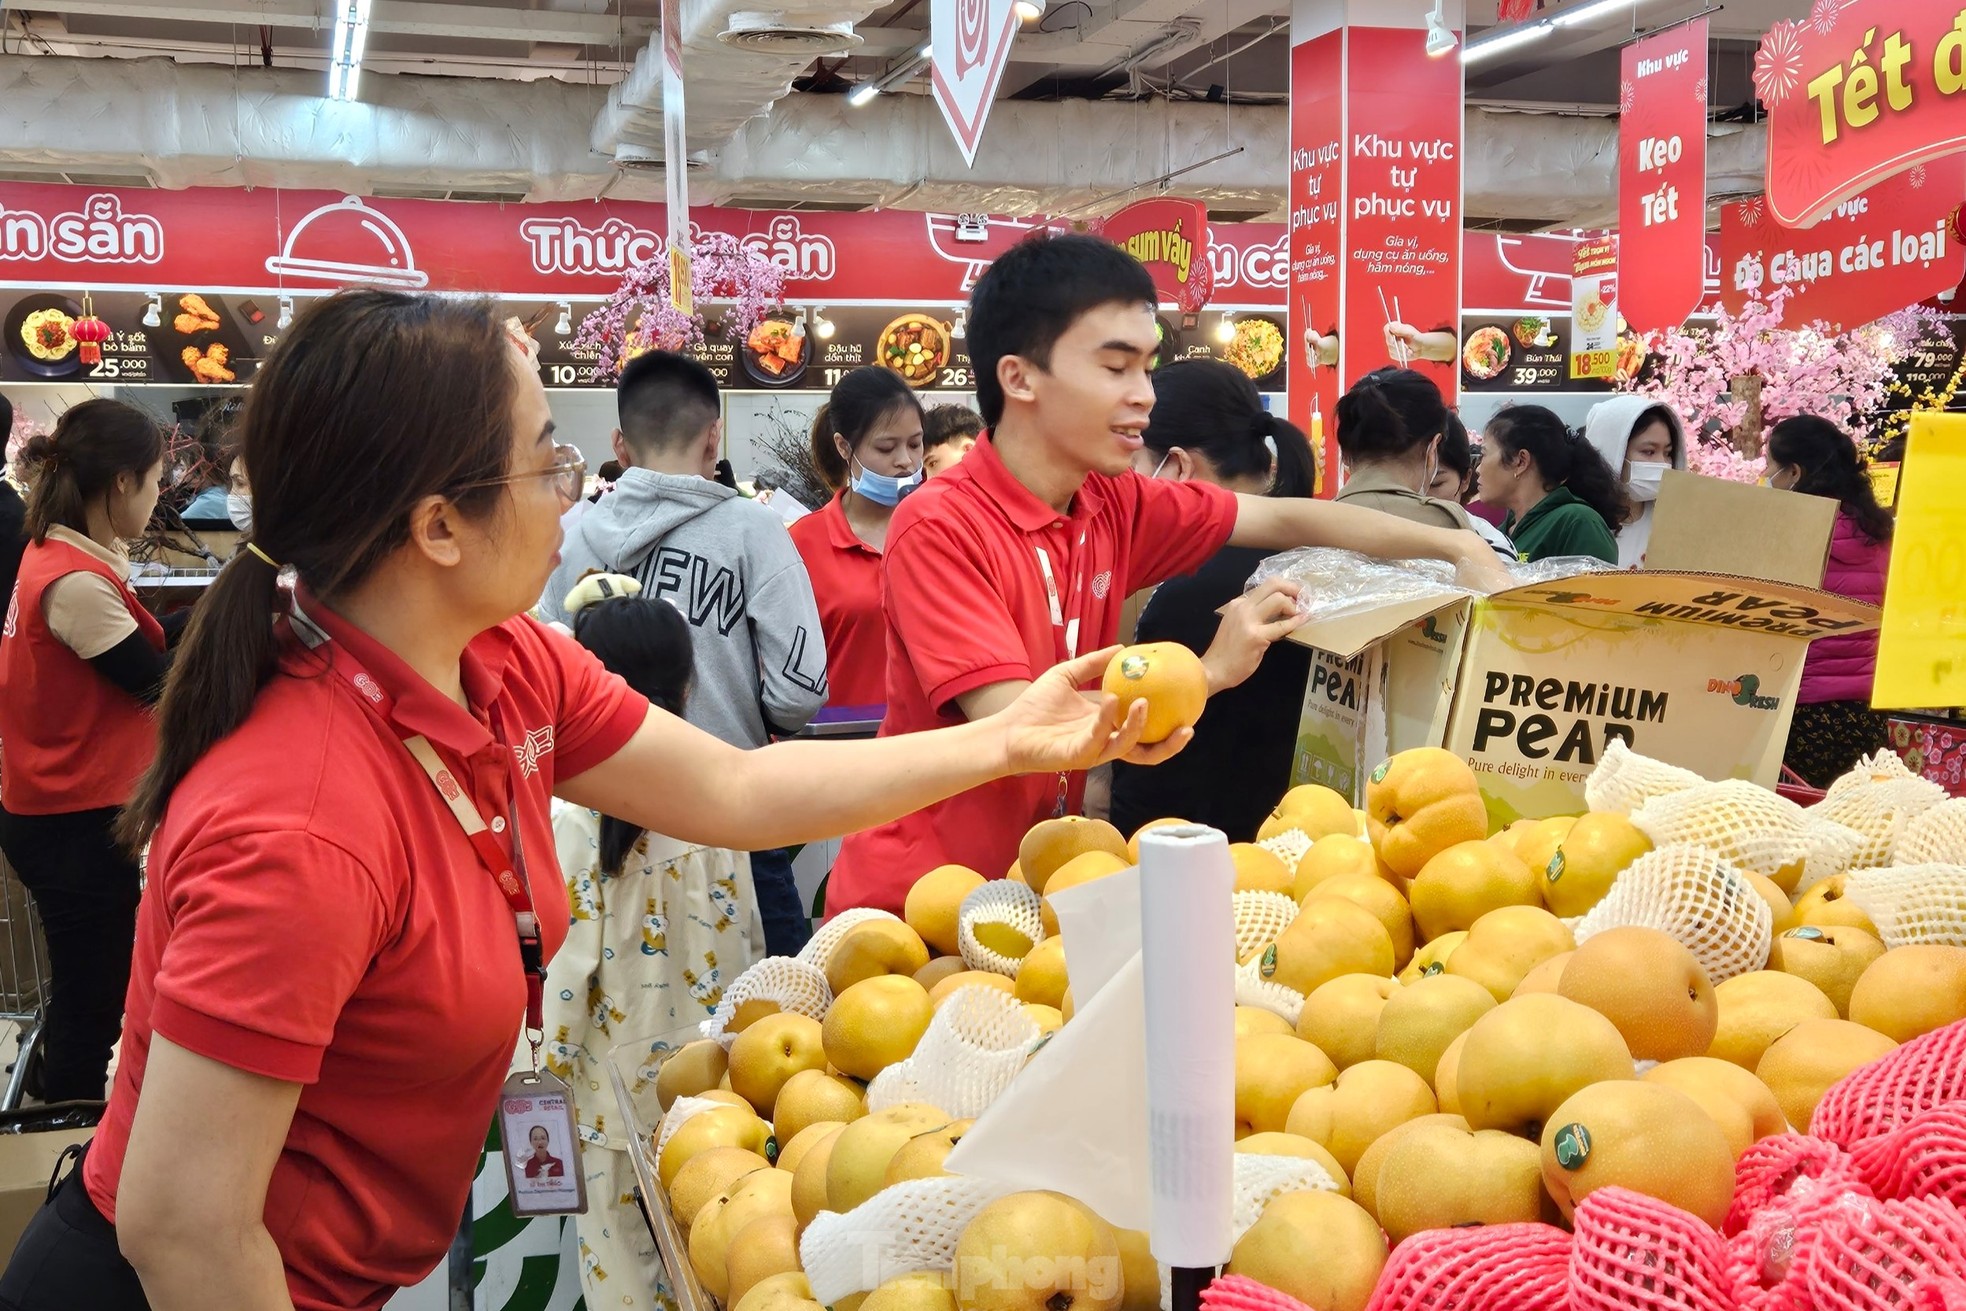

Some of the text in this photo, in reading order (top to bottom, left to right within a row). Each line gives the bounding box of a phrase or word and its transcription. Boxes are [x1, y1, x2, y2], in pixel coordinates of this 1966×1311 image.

[1637, 48, 1689, 79] Khu vực
[1807, 27, 1913, 145] Tết
[1293, 141, 1339, 172] Khu vực
[1354, 133, 1454, 165] Khu vực
[1638, 135, 1682, 175] Kẹo
[1309, 173, 1322, 200] tự
[1390, 165, 1418, 193] tự
[1293, 201, 1337, 233] phục vụ
[1354, 192, 1451, 223] phục vụ
[1641, 181, 1679, 227] Tết
[1836, 196, 1868, 222] vực
[56, 200, 156, 257] sẵn
[1385, 235, 1404, 247] Gia
[525, 221, 657, 272] Thức
[1353, 248, 1383, 262] dụng
[1385, 250, 1399, 261] cụ
[1402, 249, 1416, 260] ăn
[1839, 234, 1885, 274] các
[1892, 218, 1946, 269] loại
[102, 342, 118, 352] bò
[694, 342, 734, 353] Gà quay
[715, 353, 734, 361] con
[828, 344, 848, 353] Đậu
[846, 353, 862, 363] thịt
[1187, 345, 1211, 354] Canh
[1525, 354, 1562, 362] Bún Thái
[1914, 352, 1953, 368] 79.000
[89, 358, 147, 378] 25.000
[1514, 367, 1557, 385] 39.000
[1467, 757, 1588, 783] Pure delight in ever
